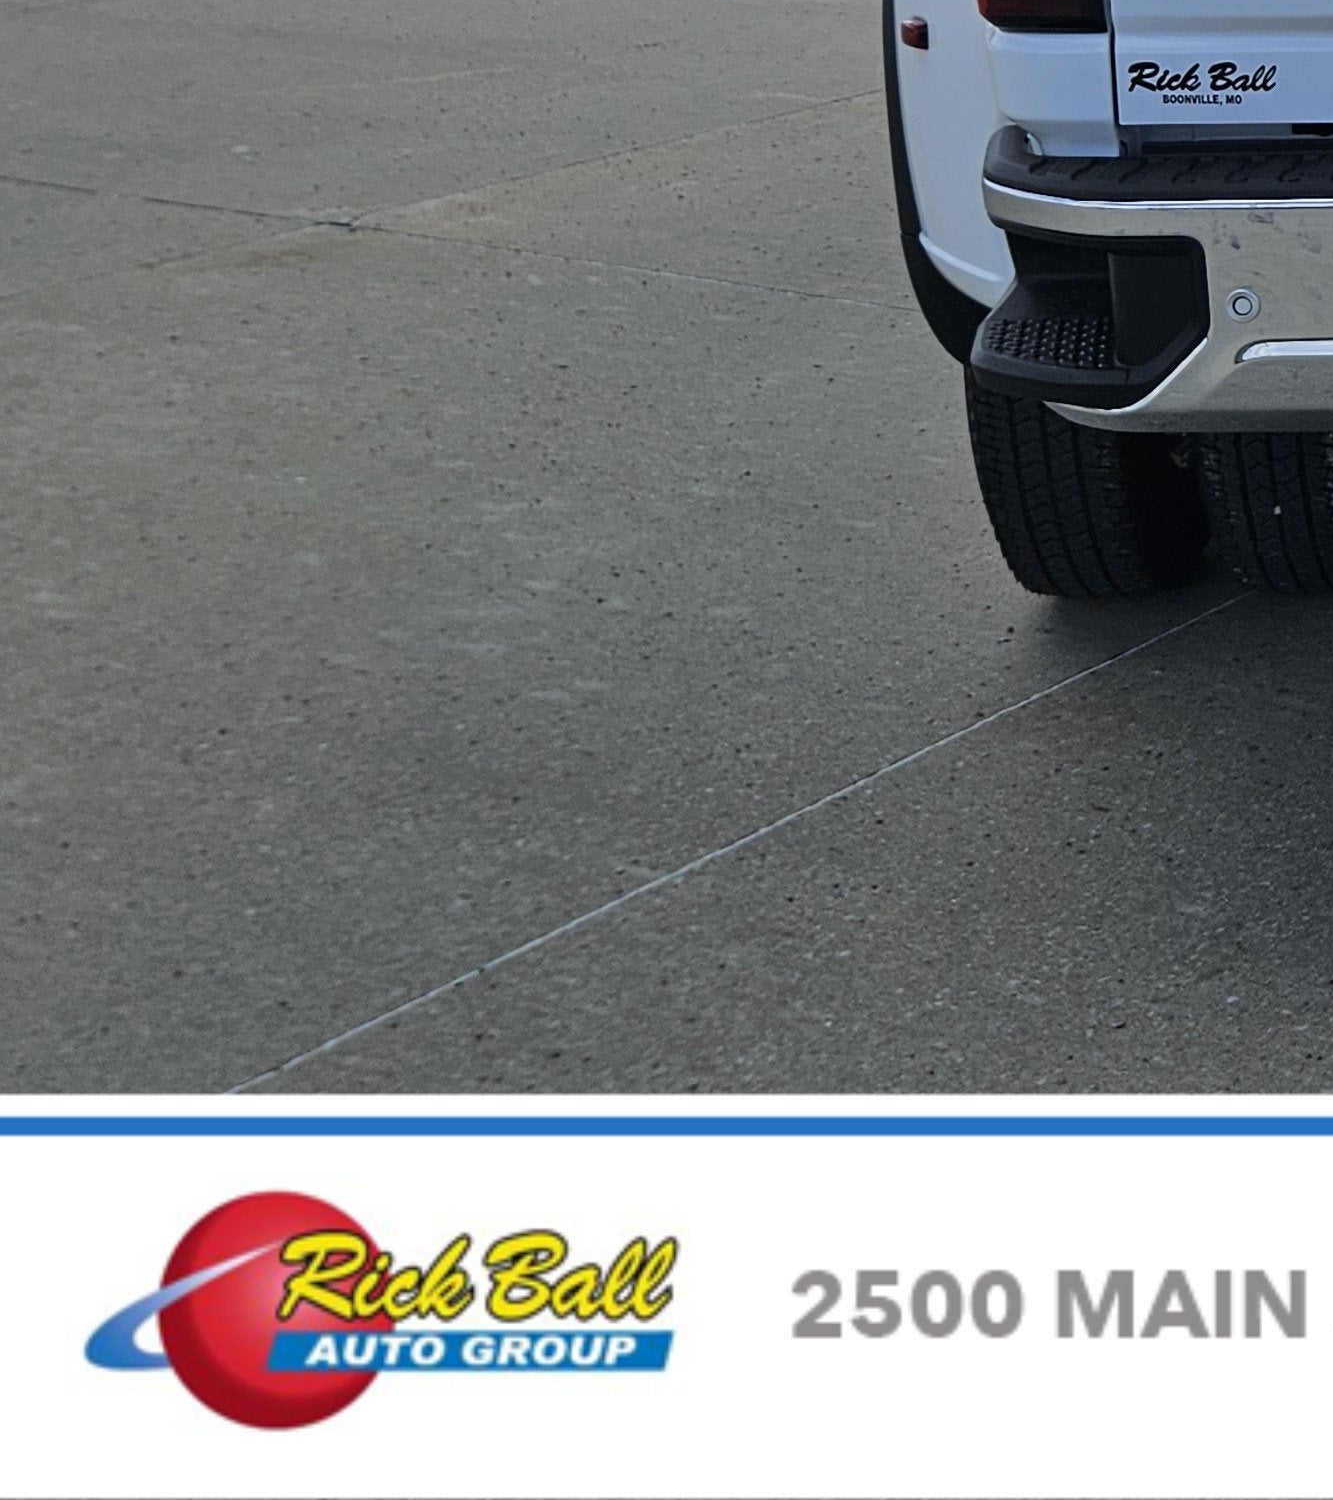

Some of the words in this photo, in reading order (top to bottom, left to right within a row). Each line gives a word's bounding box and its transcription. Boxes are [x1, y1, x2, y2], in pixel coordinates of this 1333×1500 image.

[1128, 61, 1202, 93] Rick
[1207, 61, 1277, 92] Ball
[1162, 94, 1223, 106] BOONVILLE,
[1225, 94, 1243, 105] MO
